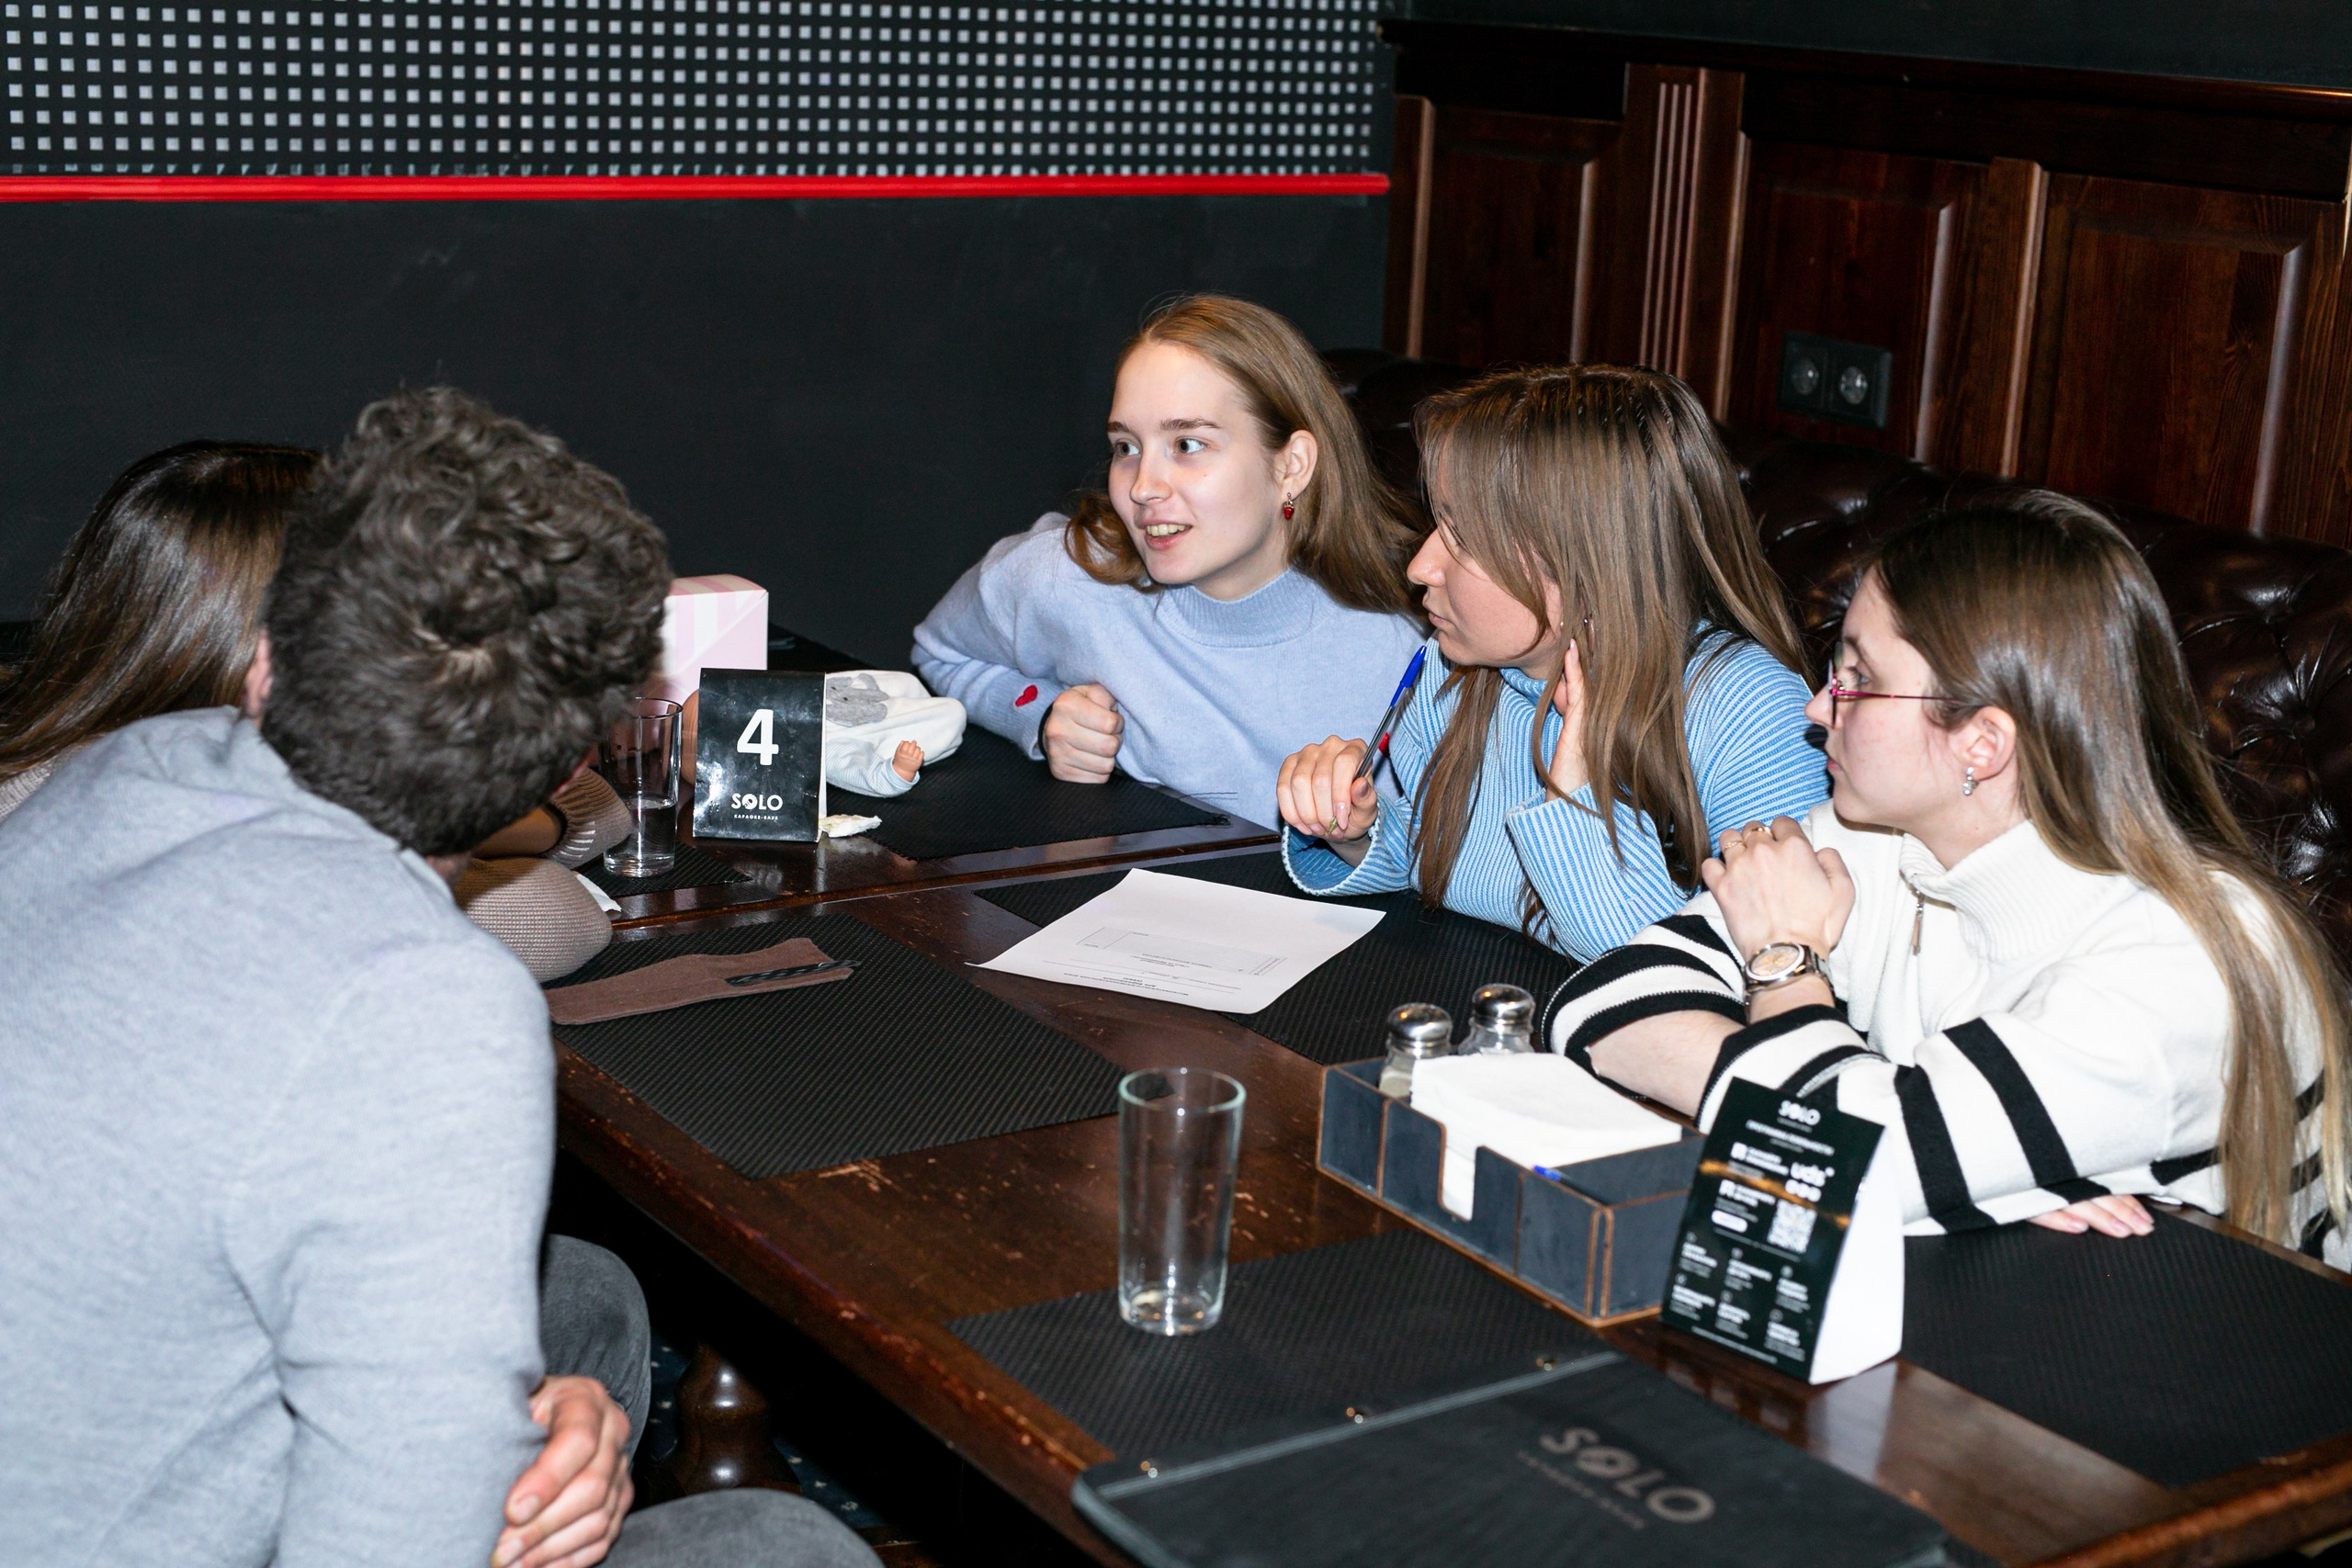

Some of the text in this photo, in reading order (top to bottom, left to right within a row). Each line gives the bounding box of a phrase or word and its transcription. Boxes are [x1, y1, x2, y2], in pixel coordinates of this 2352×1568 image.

[737, 708, 779, 766] 4
[730, 793, 784, 811] SOLO
[1539, 1427, 1716, 1524] SOLO
